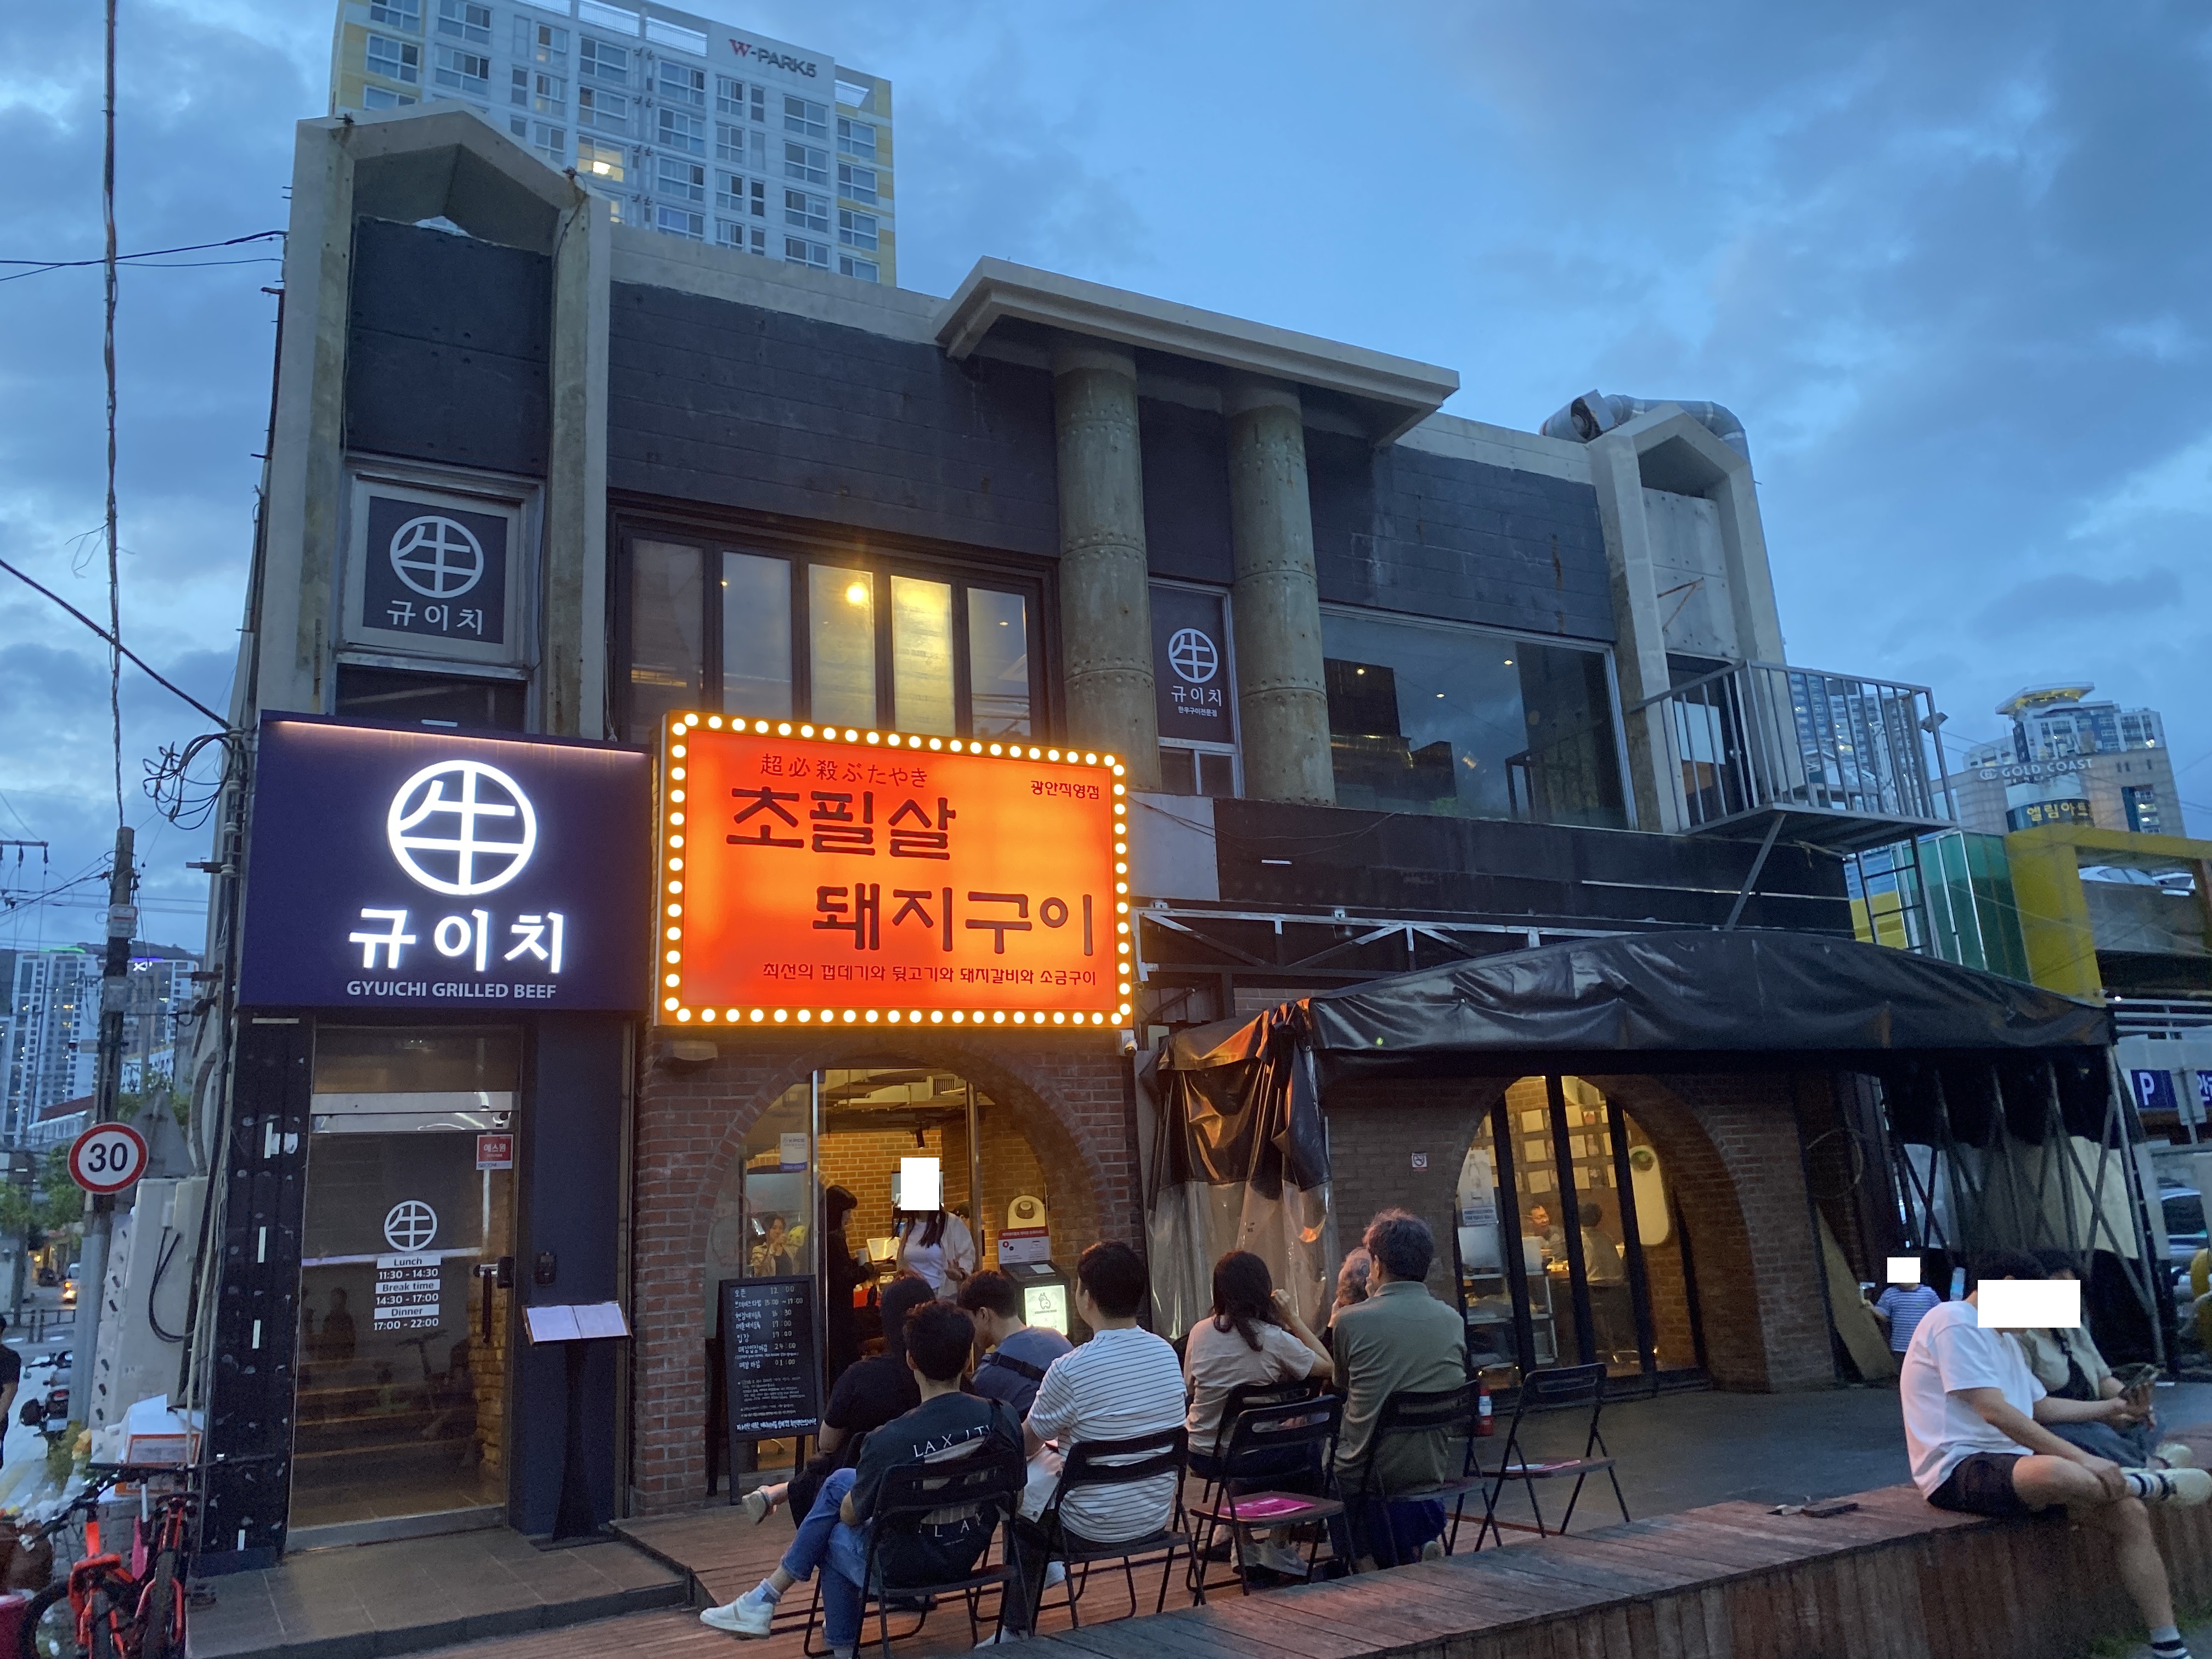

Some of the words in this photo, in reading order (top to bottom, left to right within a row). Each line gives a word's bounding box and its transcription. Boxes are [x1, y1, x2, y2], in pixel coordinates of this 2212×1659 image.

[386, 600, 483, 635] 규이치
[1171, 685, 1222, 707] 규이치
[760, 753, 928, 788] 超必殺ぶたやき
[2002, 764, 2041, 777] GOLD
[2047, 758, 2092, 772] COAST
[1030, 780, 1099, 799] 광안직영점
[726, 786, 956, 861] 초필살
[812, 883, 1094, 957] 돼지구이
[349, 908, 565, 973] 규이치
[763, 963, 814, 980] 최선의
[820, 964, 887, 981] 껍데기와
[892, 966, 954, 983] 뒷고기와
[960, 968, 1034, 984] 돼지갈비와
[1040, 970, 1096, 986] 소금구이
[346, 980, 426, 997] GYUICHI
[431, 982, 509, 998] GRILLED
[514, 984, 557, 999] BEEF
[2140, 1073, 2154, 1105] P
[88, 1142, 128, 1172] 30
[393, 1257, 422, 1267] Lunch
[379, 1270, 403, 1279] 11:30
[412, 1268, 438, 1278] 14:30
[382, 1283, 410, 1293] Break
[413, 1280, 434, 1290] time
[735, 1288, 746, 1298] 오픈
[376, 1295, 403, 1305] 14:30
[412, 1293, 438, 1303] 17:00
[391, 1308, 423, 1317] Dinner
[374, 1321, 401, 1331] 17:00
[410, 1318, 439, 1328] 22:00
[737, 1333, 749, 1344] 입장
